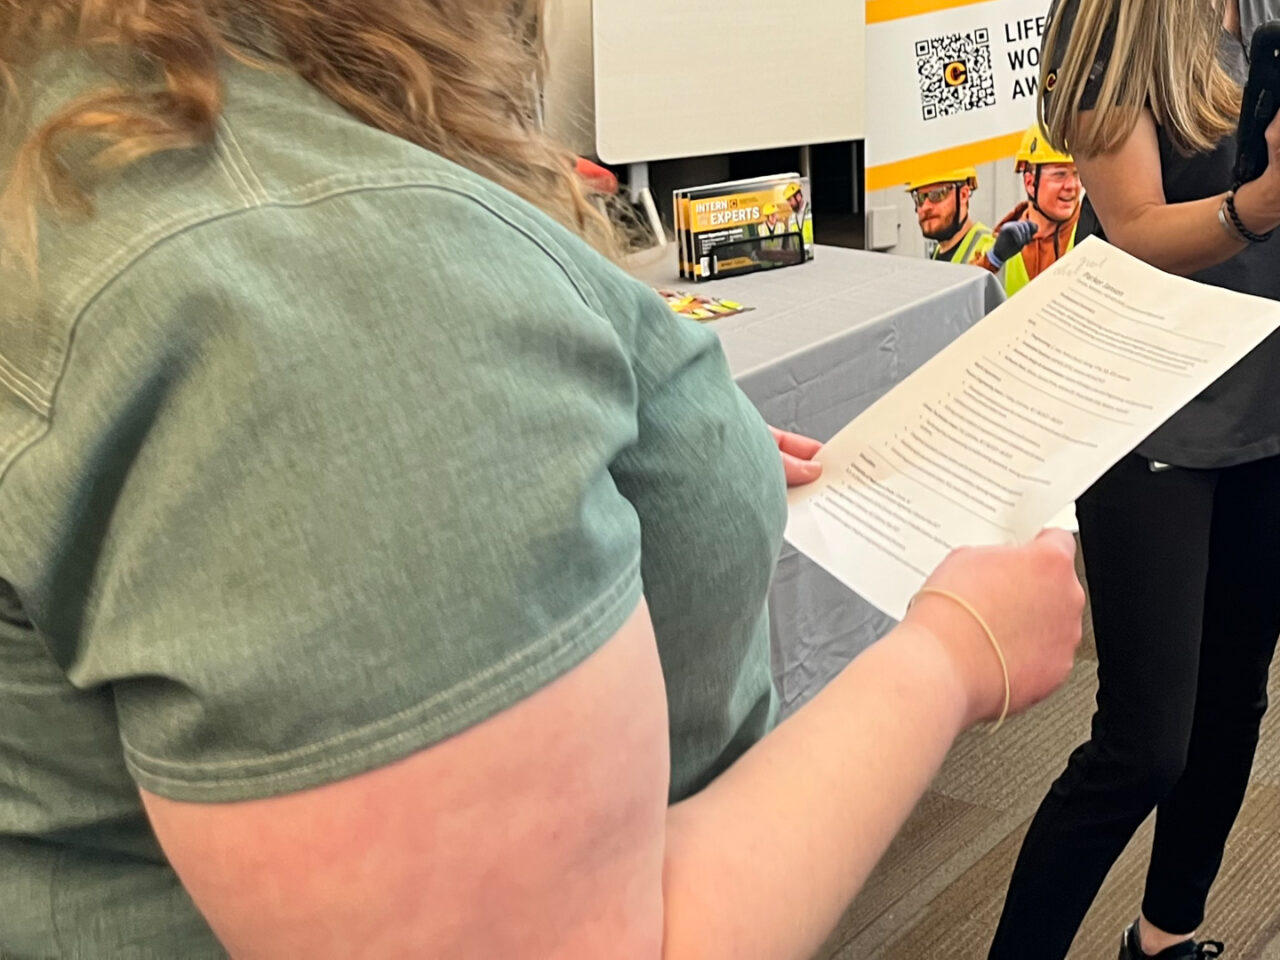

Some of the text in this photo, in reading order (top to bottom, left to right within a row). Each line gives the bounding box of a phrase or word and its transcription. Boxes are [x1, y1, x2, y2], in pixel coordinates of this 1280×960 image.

[1007, 46, 1041, 71] WO
[1012, 75, 1039, 100] AW
[695, 199, 728, 214] INTERN
[710, 206, 760, 226] EXPERTS
